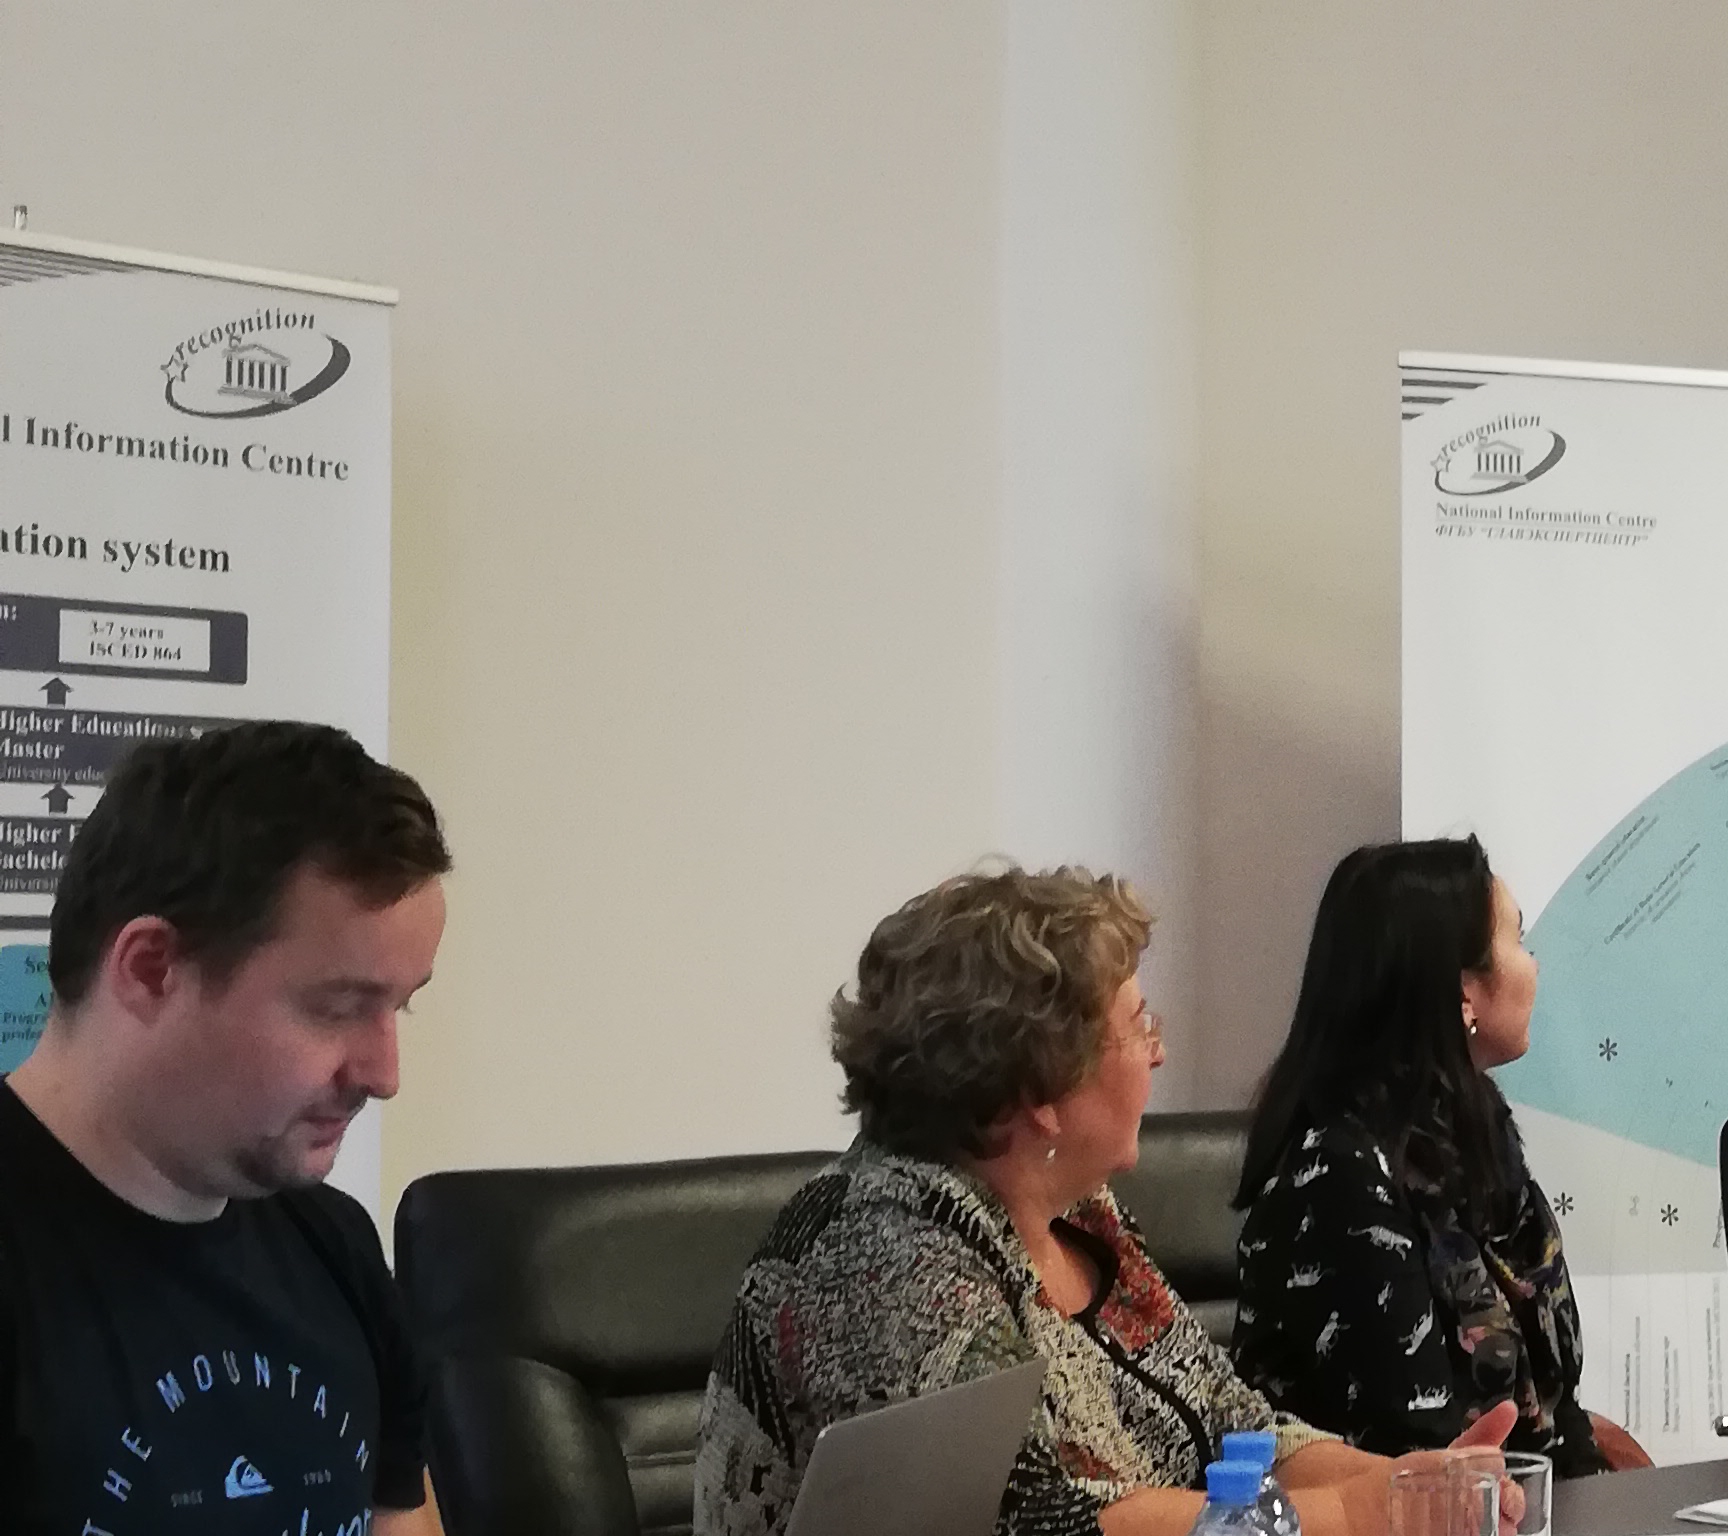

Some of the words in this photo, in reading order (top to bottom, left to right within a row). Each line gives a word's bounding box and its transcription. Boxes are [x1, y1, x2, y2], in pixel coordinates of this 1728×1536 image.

[176, 307, 316, 361] recognition
[25, 415, 229, 469] Information
[241, 442, 349, 482] Centre
[1440, 413, 1541, 458] recognition
[1436, 502, 1503, 520] National
[1509, 505, 1601, 525] Information
[1606, 512, 1657, 529] Centre
[102, 536, 231, 574] system
[0, 850, 69, 871] achelo
[156, 1349, 370, 1473] MOUNTAIN
